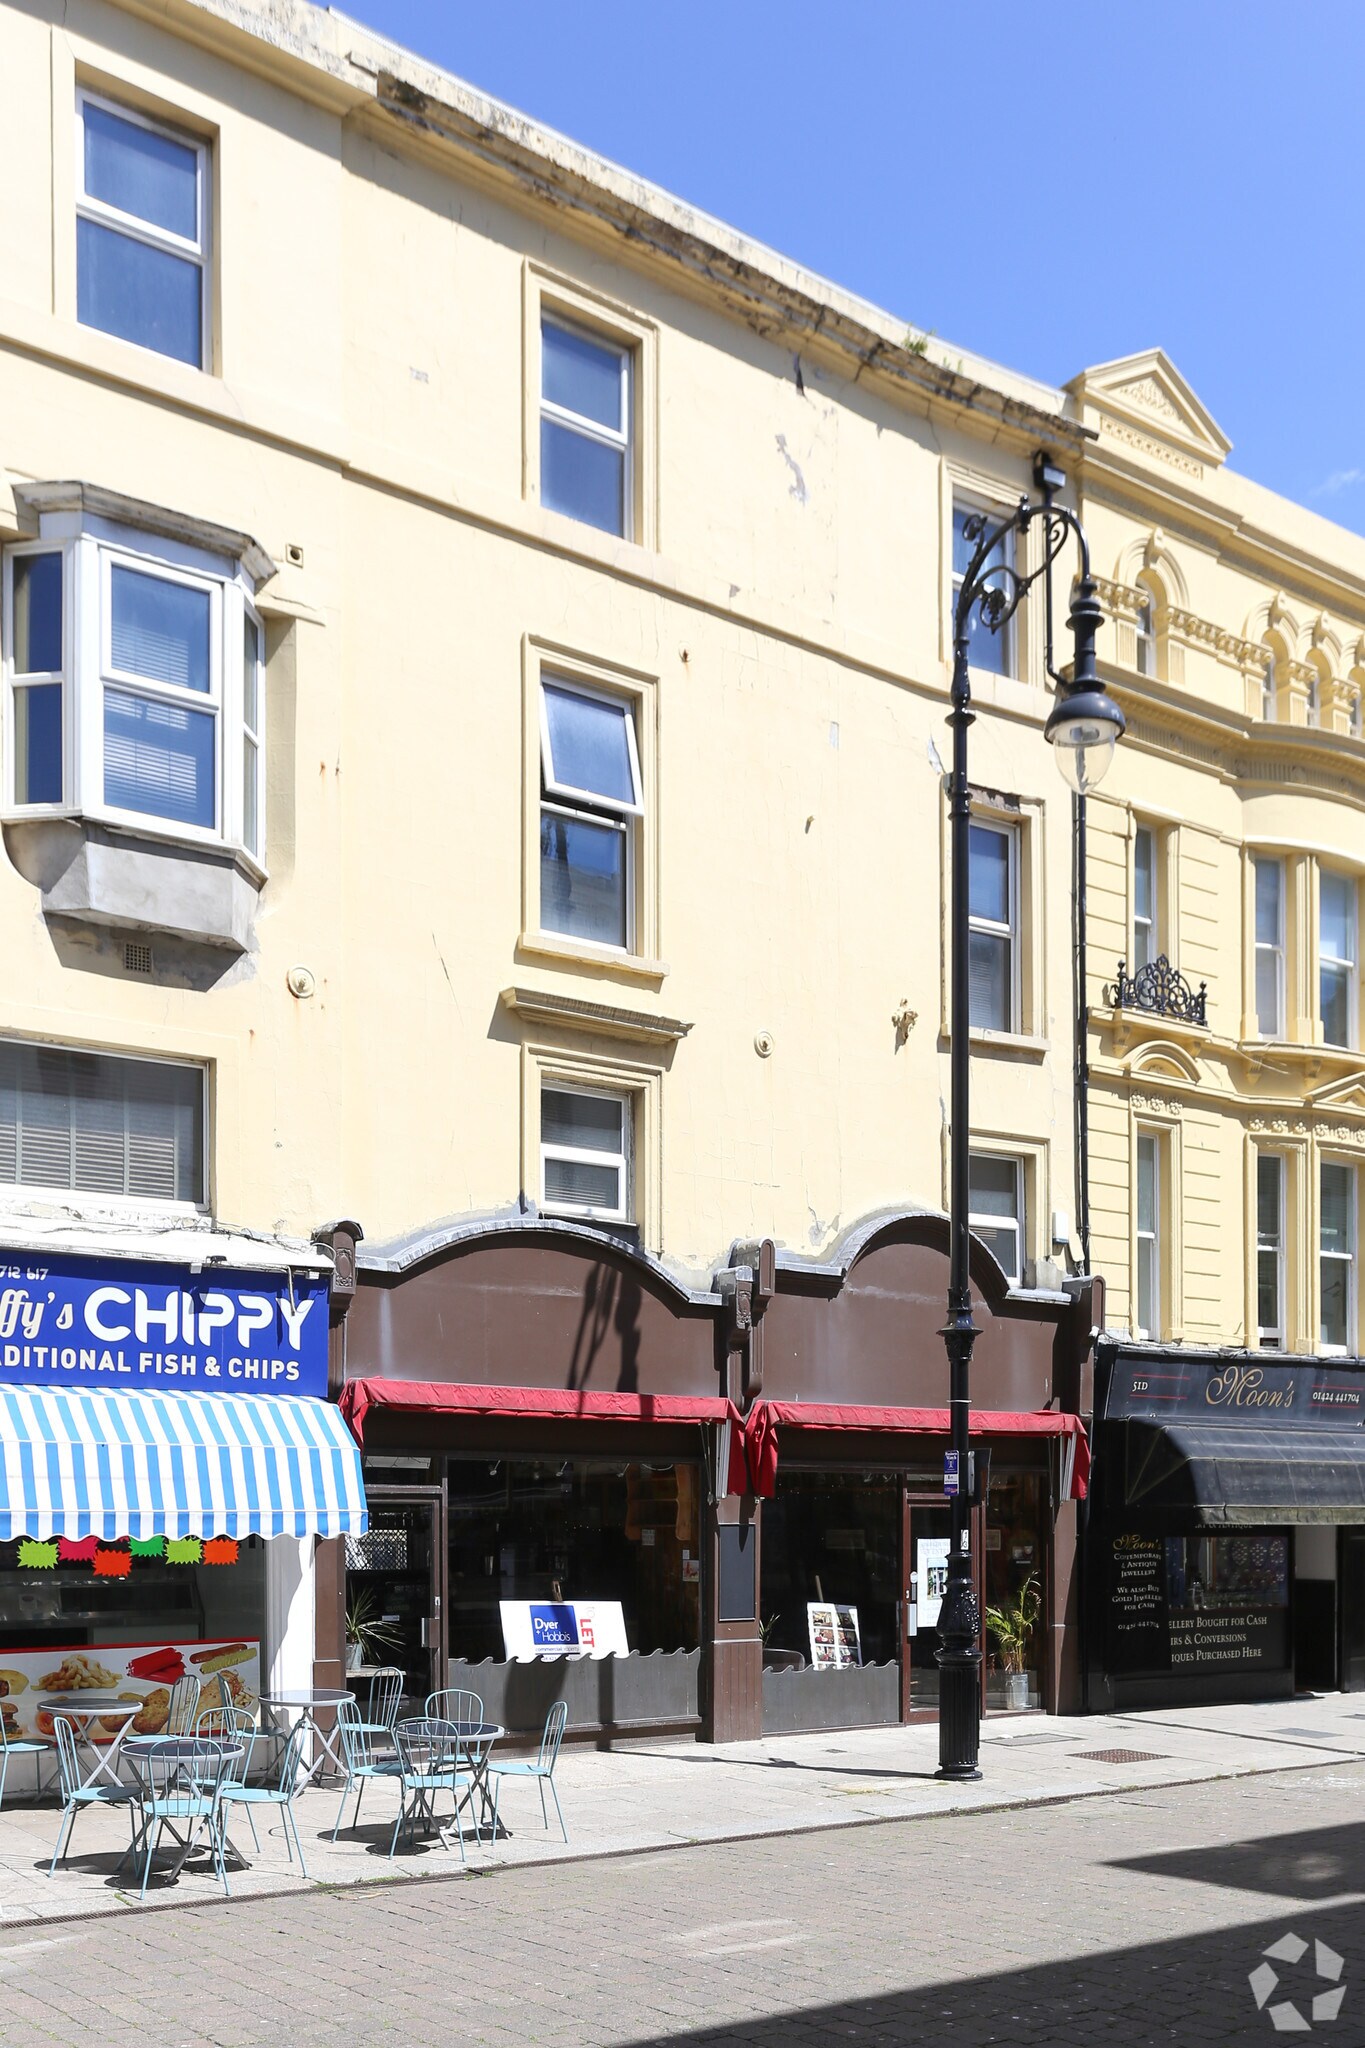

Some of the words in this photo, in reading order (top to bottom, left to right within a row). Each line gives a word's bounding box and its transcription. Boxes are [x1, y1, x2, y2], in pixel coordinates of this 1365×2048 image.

[26, 1267, 49, 1281] 617
[84, 1287, 315, 1351] CHIPPY
[0, 1344, 131, 1373] DITIONAL
[139, 1352, 197, 1376] FISH
[204, 1356, 221, 1378] &
[228, 1358, 300, 1381] CHIPS
[1205, 1366, 1295, 1409] Moon's
[1312, 1391, 1333, 1403] 01424
[1335, 1392, 1360, 1404] 441704
[534, 1618, 558, 1631] Dyer
[1196, 1616, 1230, 1628] BOUGHT
[1231, 1617, 1245, 1626] FOR
[1246, 1614, 1267, 1626] CASH
[542, 1631, 571, 1641] Hobbis
[580, 1618, 595, 1647] LET
[1184, 1634, 1192, 1645] &
[1194, 1633, 1247, 1644] CONVERSIONS
[1196, 1649, 1240, 1661] PURCHASED
[1242, 1647, 1262, 1658] HERE
